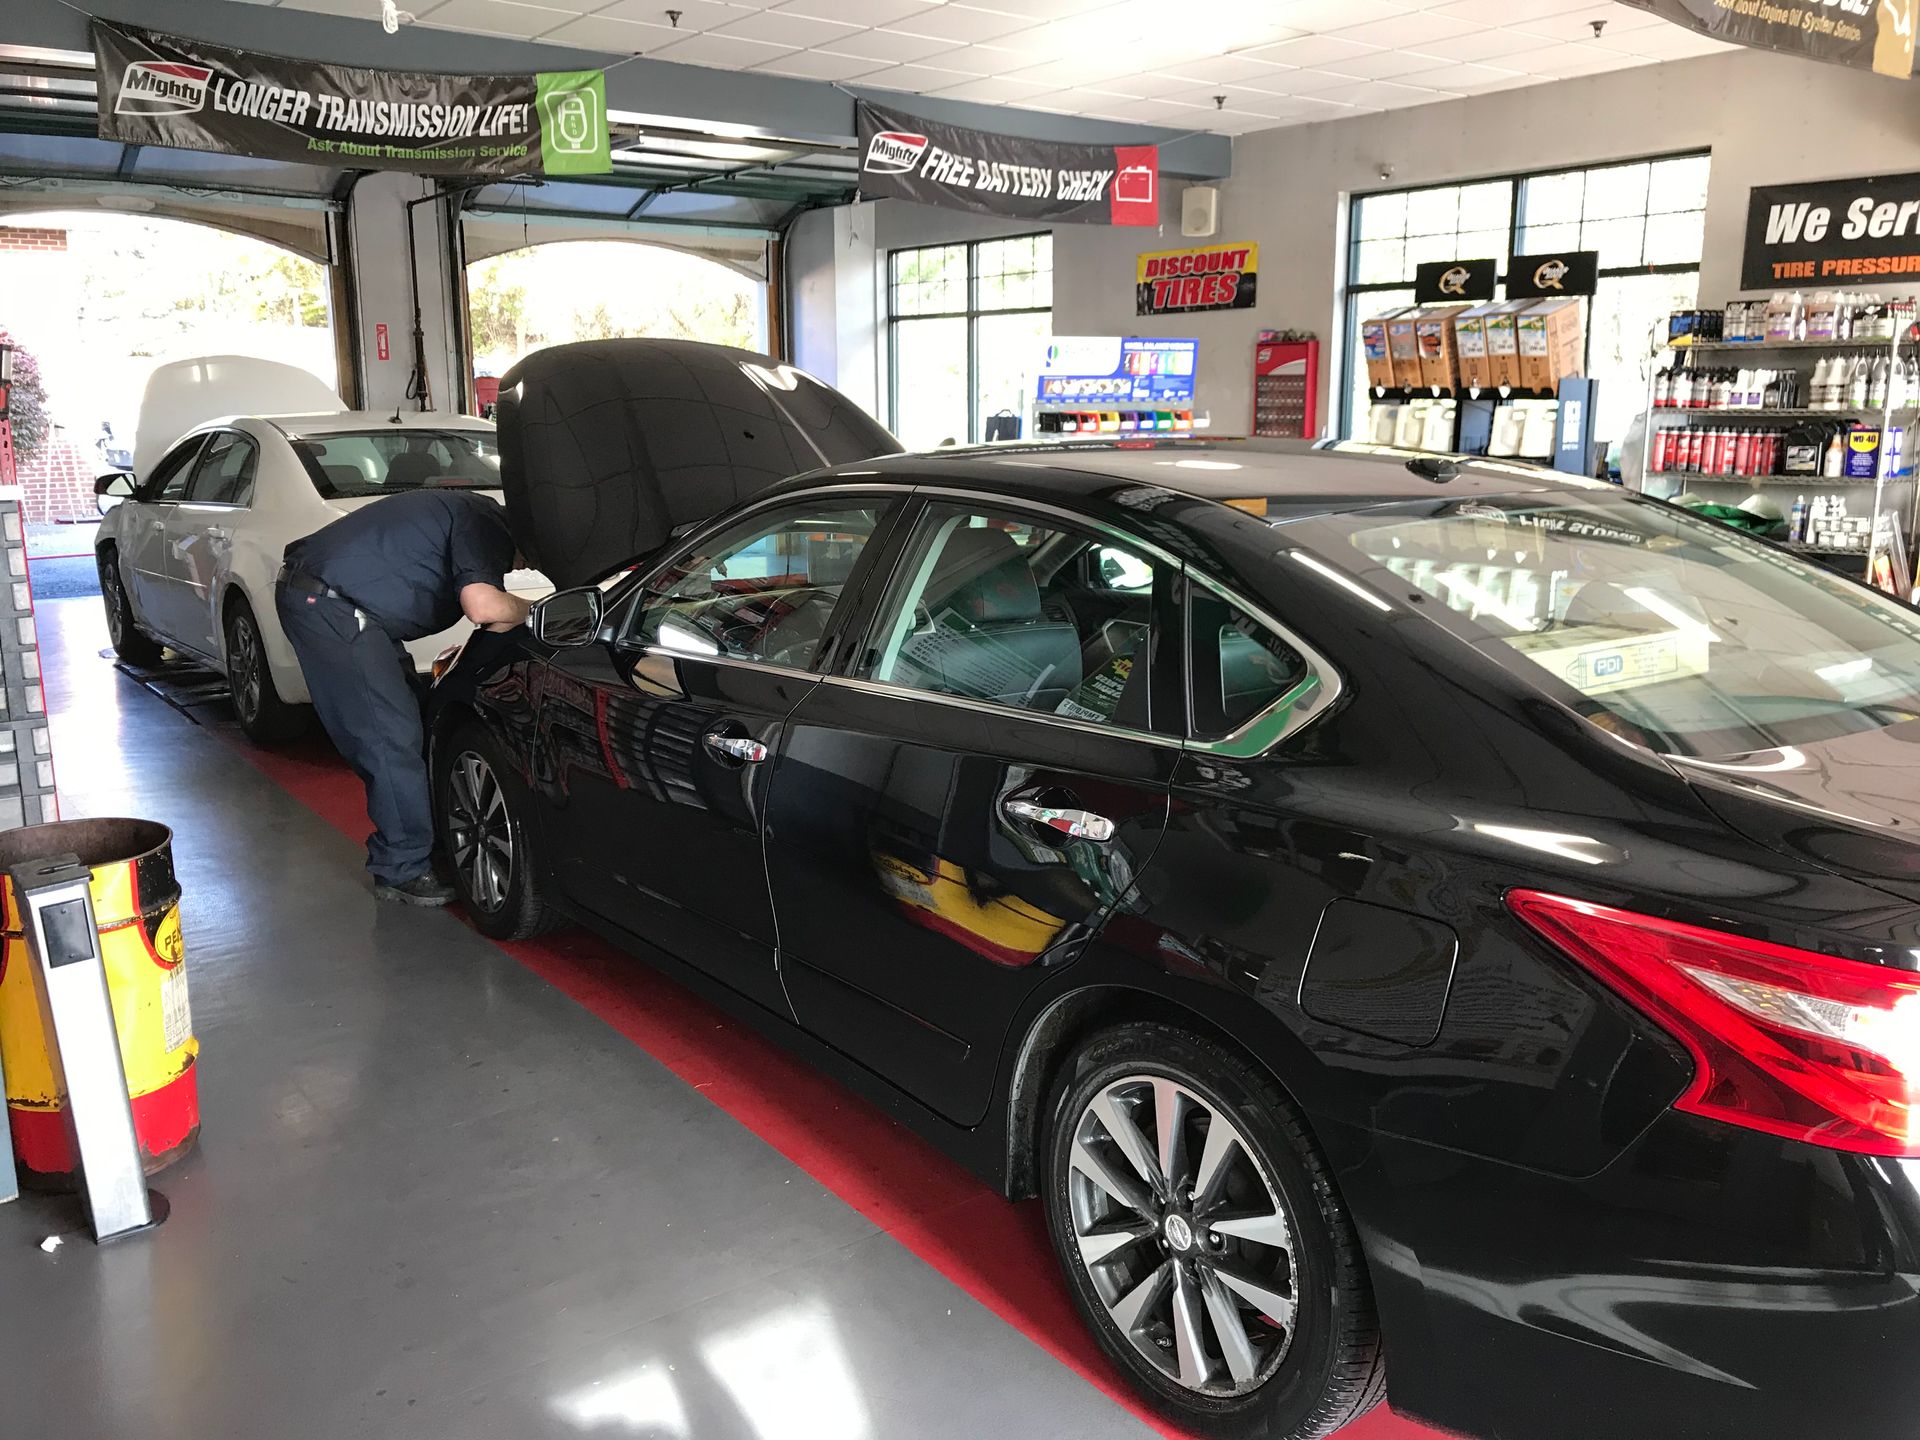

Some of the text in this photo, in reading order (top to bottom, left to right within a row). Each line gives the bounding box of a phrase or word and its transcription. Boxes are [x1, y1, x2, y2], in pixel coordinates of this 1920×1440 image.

[1759, 1, 1788, 24] Engine
[1788, 9, 1803, 26] Oil
[125, 68, 201, 106] Mighty
[213, 78, 530, 138] LONGER TRANSMISSION LIFE!
[307, 137, 528, 159] Ask About Transmission Service
[871, 138, 917, 166] Mighty
[920, 147, 1114, 202] FREE BATTERY CHECK
[1765, 202, 1831, 245] We
[1145, 249, 1251, 277] DISCOUNT
[1772, 255, 1920, 280] TIRE PRESSUR
[1151, 273, 1241, 310] TIRES
[1597, 658, 1621, 676] PDI
